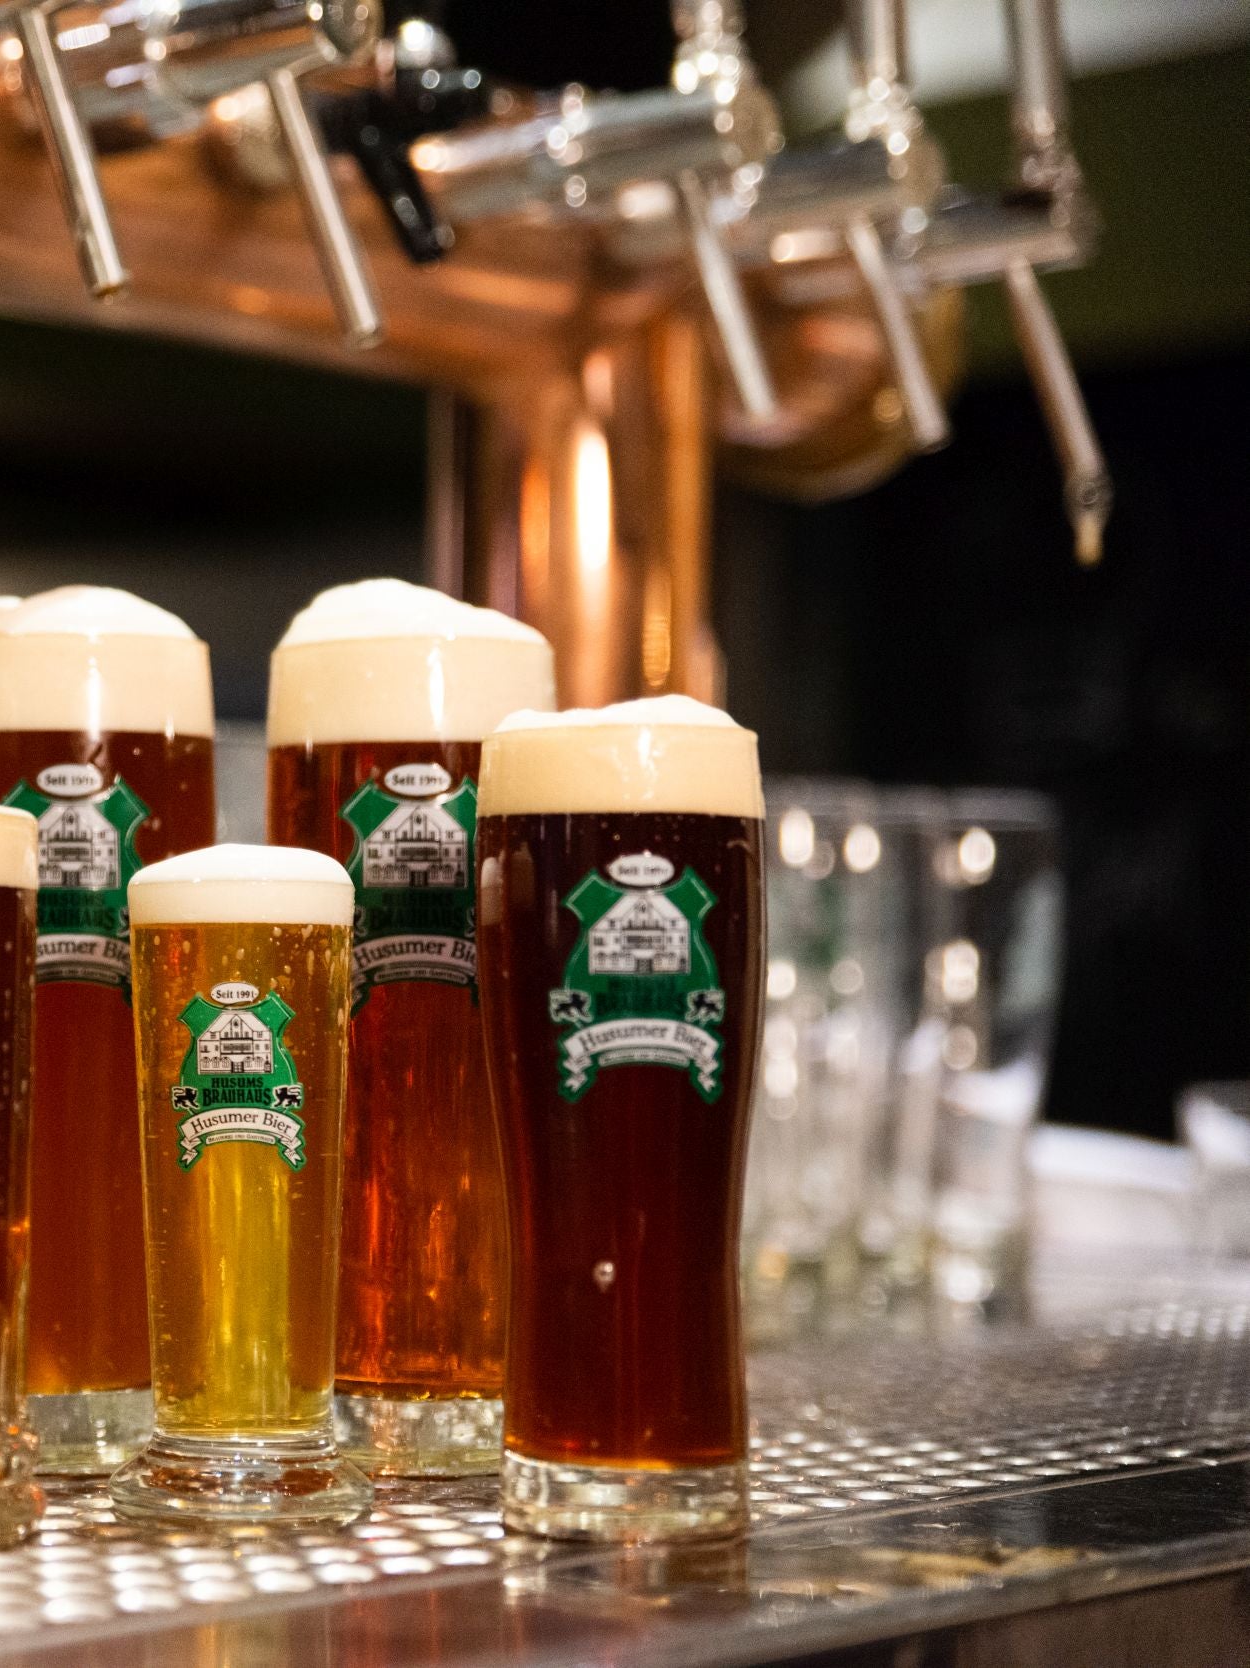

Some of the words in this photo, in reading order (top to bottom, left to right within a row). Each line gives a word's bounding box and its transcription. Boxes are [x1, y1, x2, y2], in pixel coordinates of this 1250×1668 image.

[36, 941, 97, 956] sumer
[354, 940, 446, 968] Husumer
[216, 989, 233, 999] Seit
[236, 989, 255, 999] 1991
[211, 1076, 264, 1089] HUSUMS
[202, 1087, 273, 1107] BRAUHAUS
[190, 1112, 259, 1135] Husumer
[262, 1112, 292, 1134] Bier
